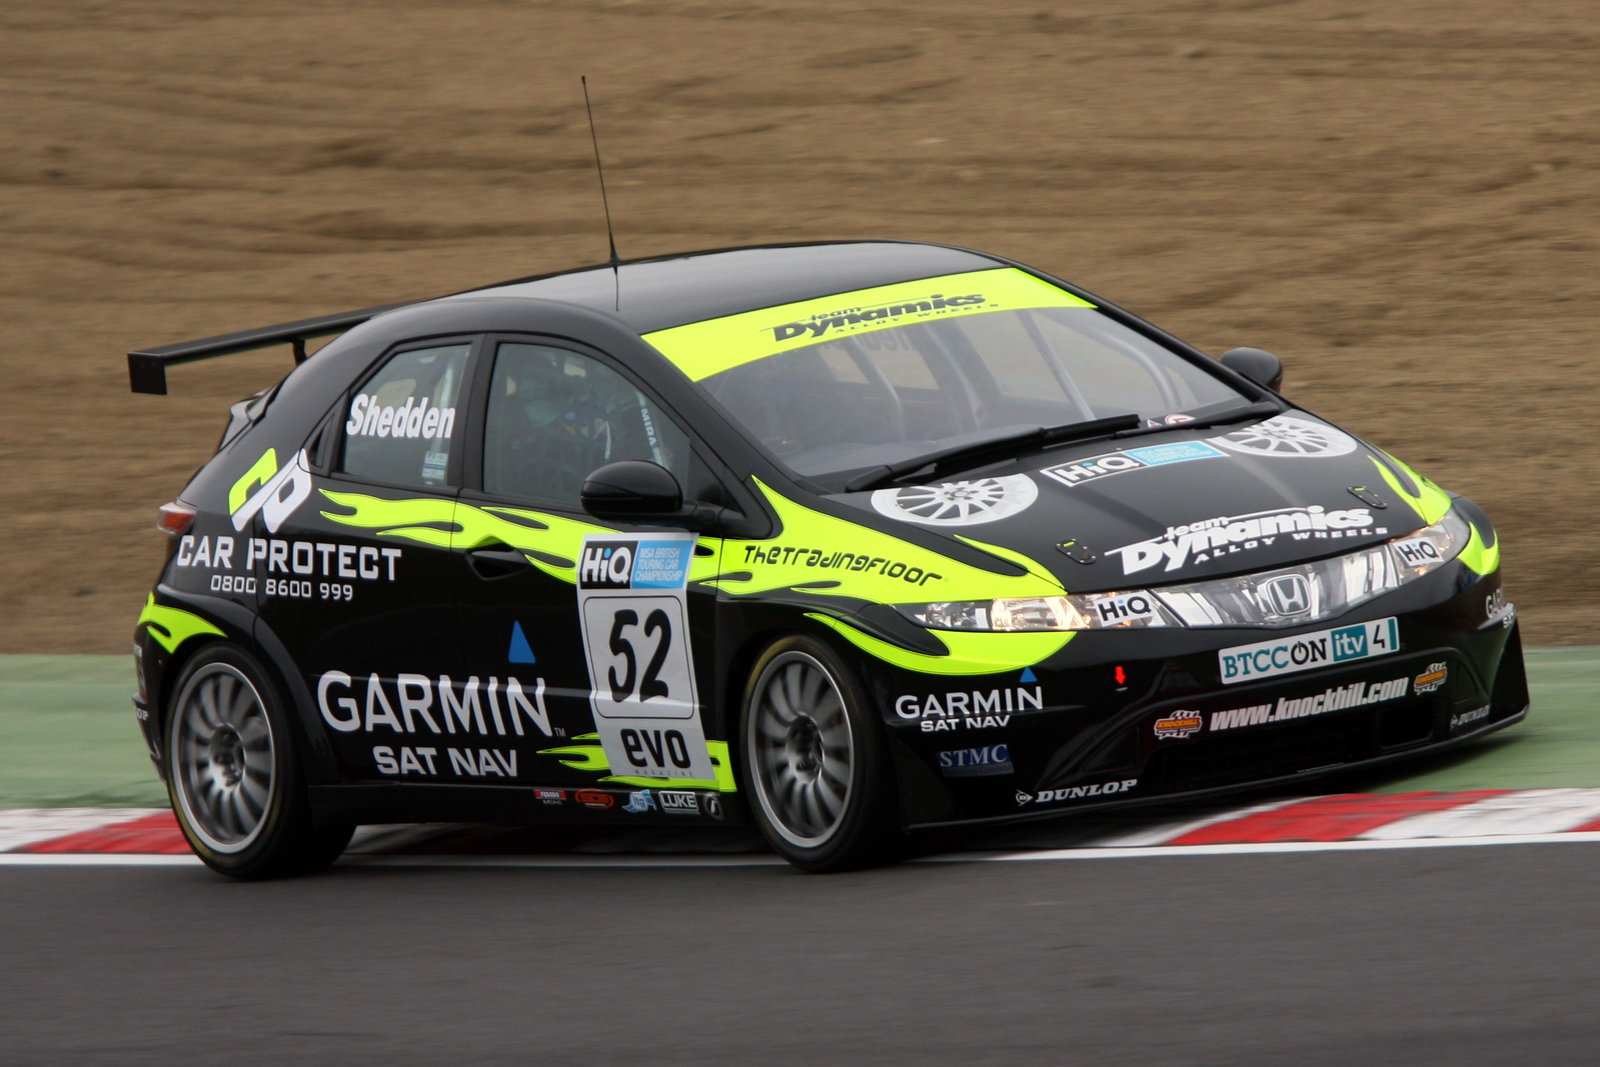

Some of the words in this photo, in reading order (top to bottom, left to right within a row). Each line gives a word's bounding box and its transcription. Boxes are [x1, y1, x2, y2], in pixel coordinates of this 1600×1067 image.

[773, 294, 986, 342] Dynamics
[811, 307, 862, 321] team
[346, 393, 455, 439] Shedden
[1053, 456, 1140, 482] HiQ
[1121, 505, 1375, 576] Dynamics
[1164, 516, 1230, 541] team
[176, 535, 234, 568] CAR
[246, 538, 402, 581] PROTECT
[1194, 536, 1277, 565] ALLOY
[1291, 527, 1388, 541] WHEELS
[1398, 538, 1440, 563] HiQ
[581, 546, 632, 584] HiQ
[211, 574, 257, 594] 0800
[265, 578, 312, 598] 8600
[319, 583, 353, 600] 999
[1098, 596, 1152, 622] HiQ
[608, 608, 672, 703] 52
[1334, 634, 1364, 657] itv
[317, 670, 552, 737] GARMIN
[895, 686, 1044, 719] GARMIN
[1209, 676, 1410, 732] www.knockhill.com
[921, 719, 959, 732] SAT
[965, 715, 1010, 731] NAV
[372, 746, 437, 775] SAT
[447, 748, 518, 777] NAV
[620, 728, 691, 769] evo
[939, 744, 1007, 768] STMC
[660, 794, 697, 808] LUKE
[1035, 779, 1137, 803] DUNLOP
